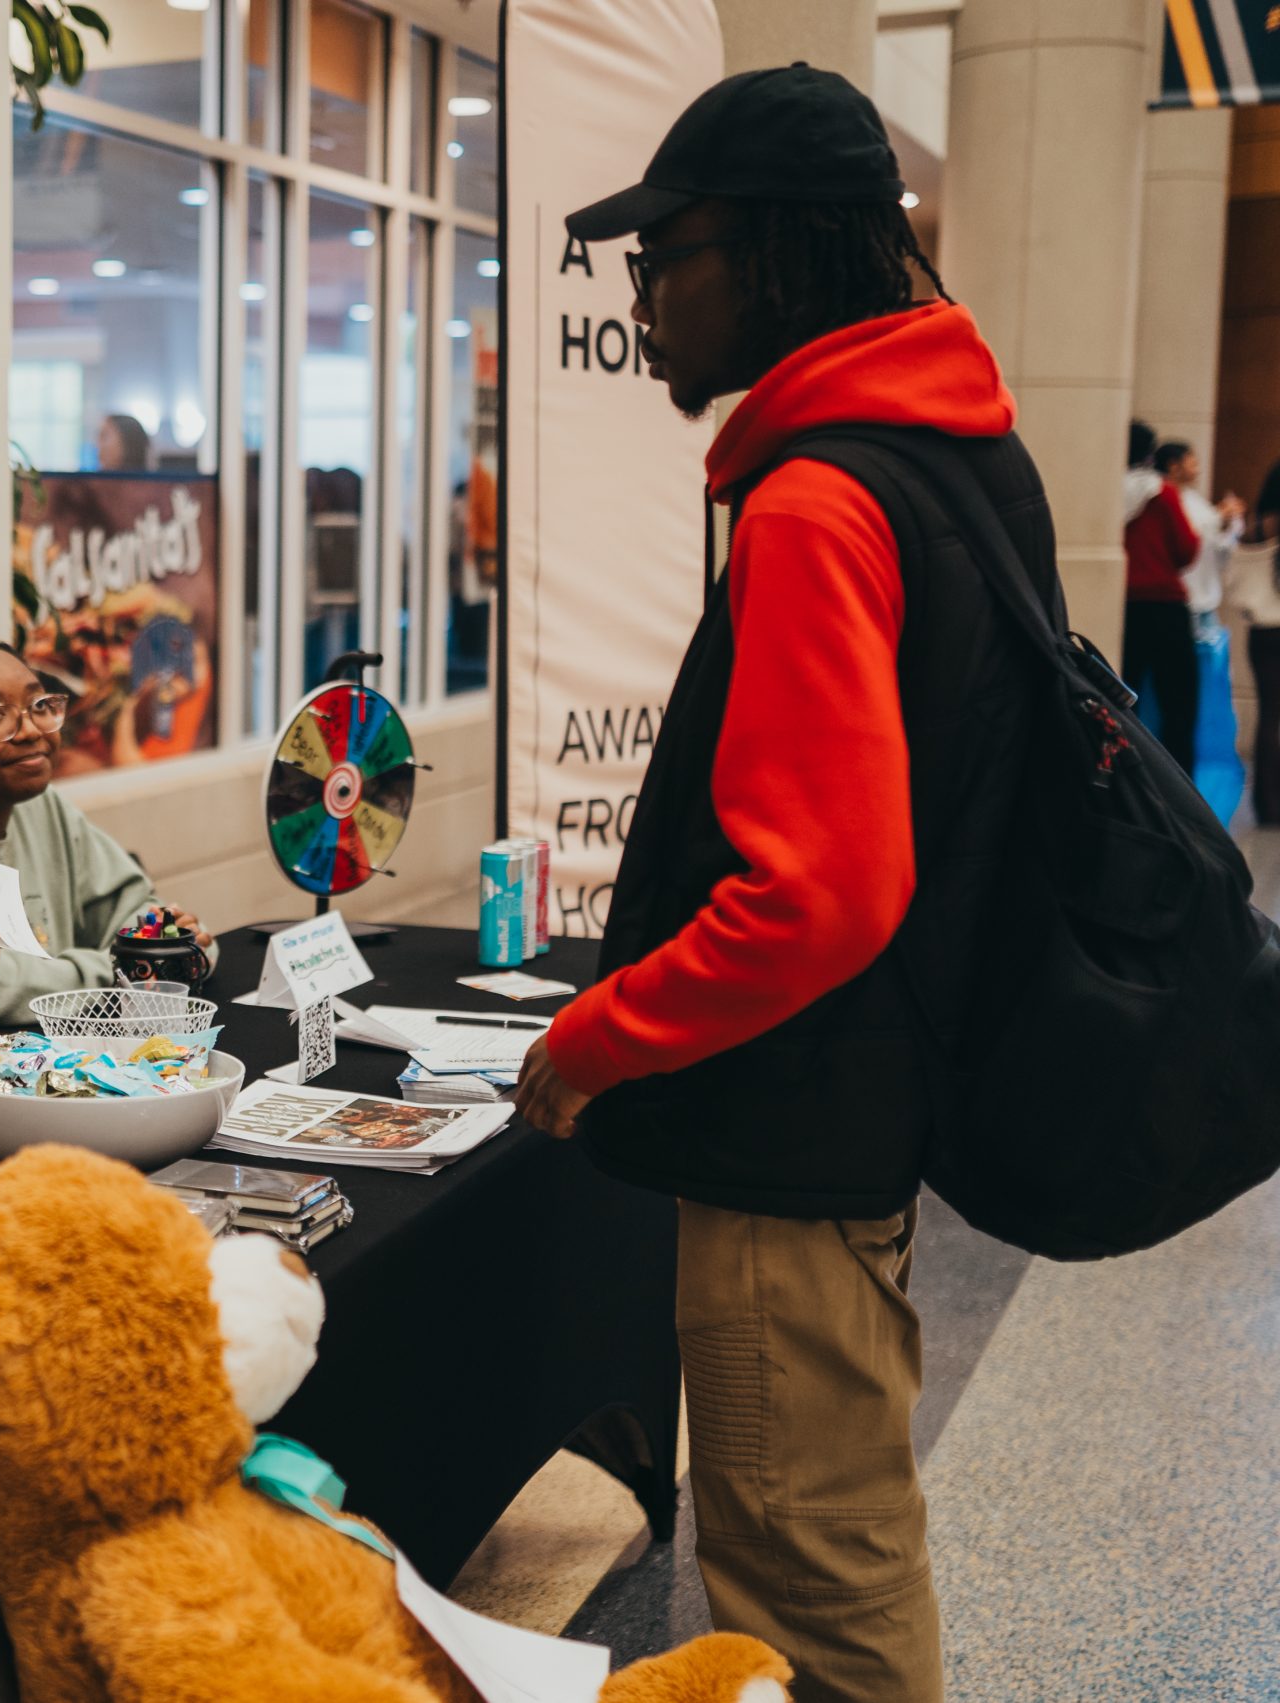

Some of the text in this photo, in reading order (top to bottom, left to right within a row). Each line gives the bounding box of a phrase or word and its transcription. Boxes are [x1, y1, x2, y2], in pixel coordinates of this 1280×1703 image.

[560, 236, 594, 278] A
[556, 706, 665, 766] AWA
[223, 1093, 347, 1136] BLOCK
